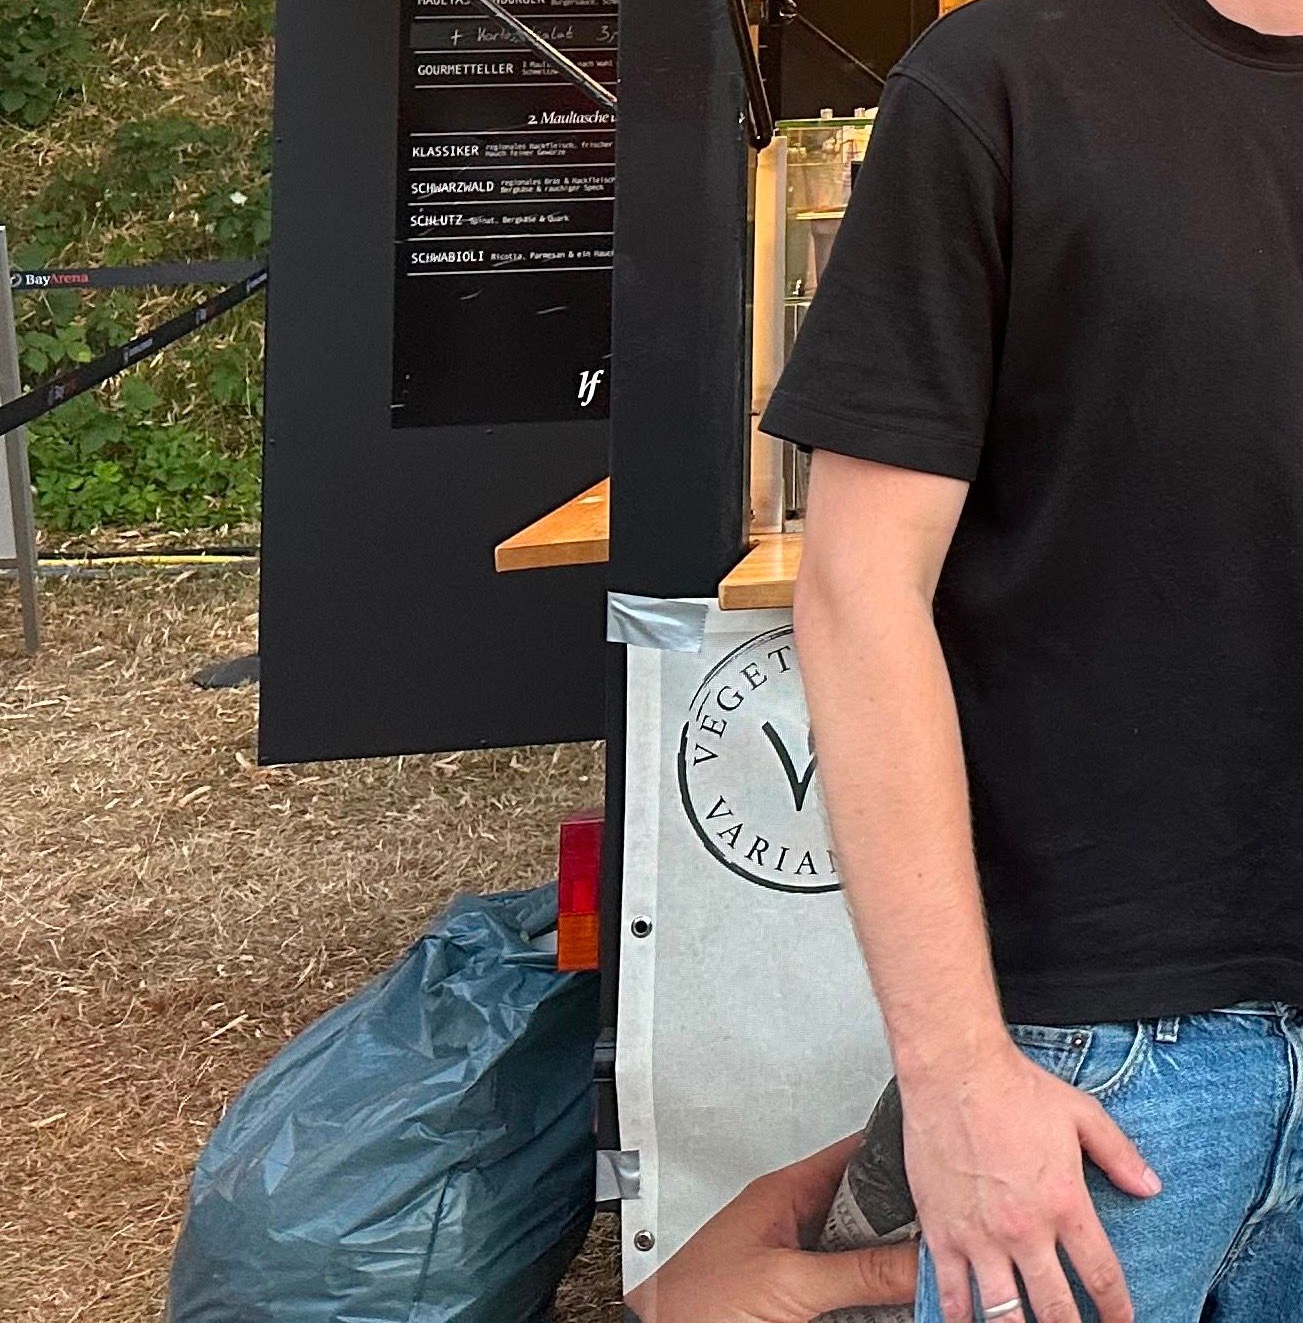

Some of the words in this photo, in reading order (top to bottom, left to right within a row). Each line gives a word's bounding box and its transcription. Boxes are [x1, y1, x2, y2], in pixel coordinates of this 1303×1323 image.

[417, 63, 514, 76] GOURMETTELLER
[540, 110, 609, 125] Maultasche
[412, 145, 479, 158] KLASSIKER
[411, 180, 495, 196] SCHWARZWALD
[410, 214, 464, 228] SCHLUTZ
[411, 249, 485, 264] SCHWABIOLI
[25, 273, 89, 287] BayArena
